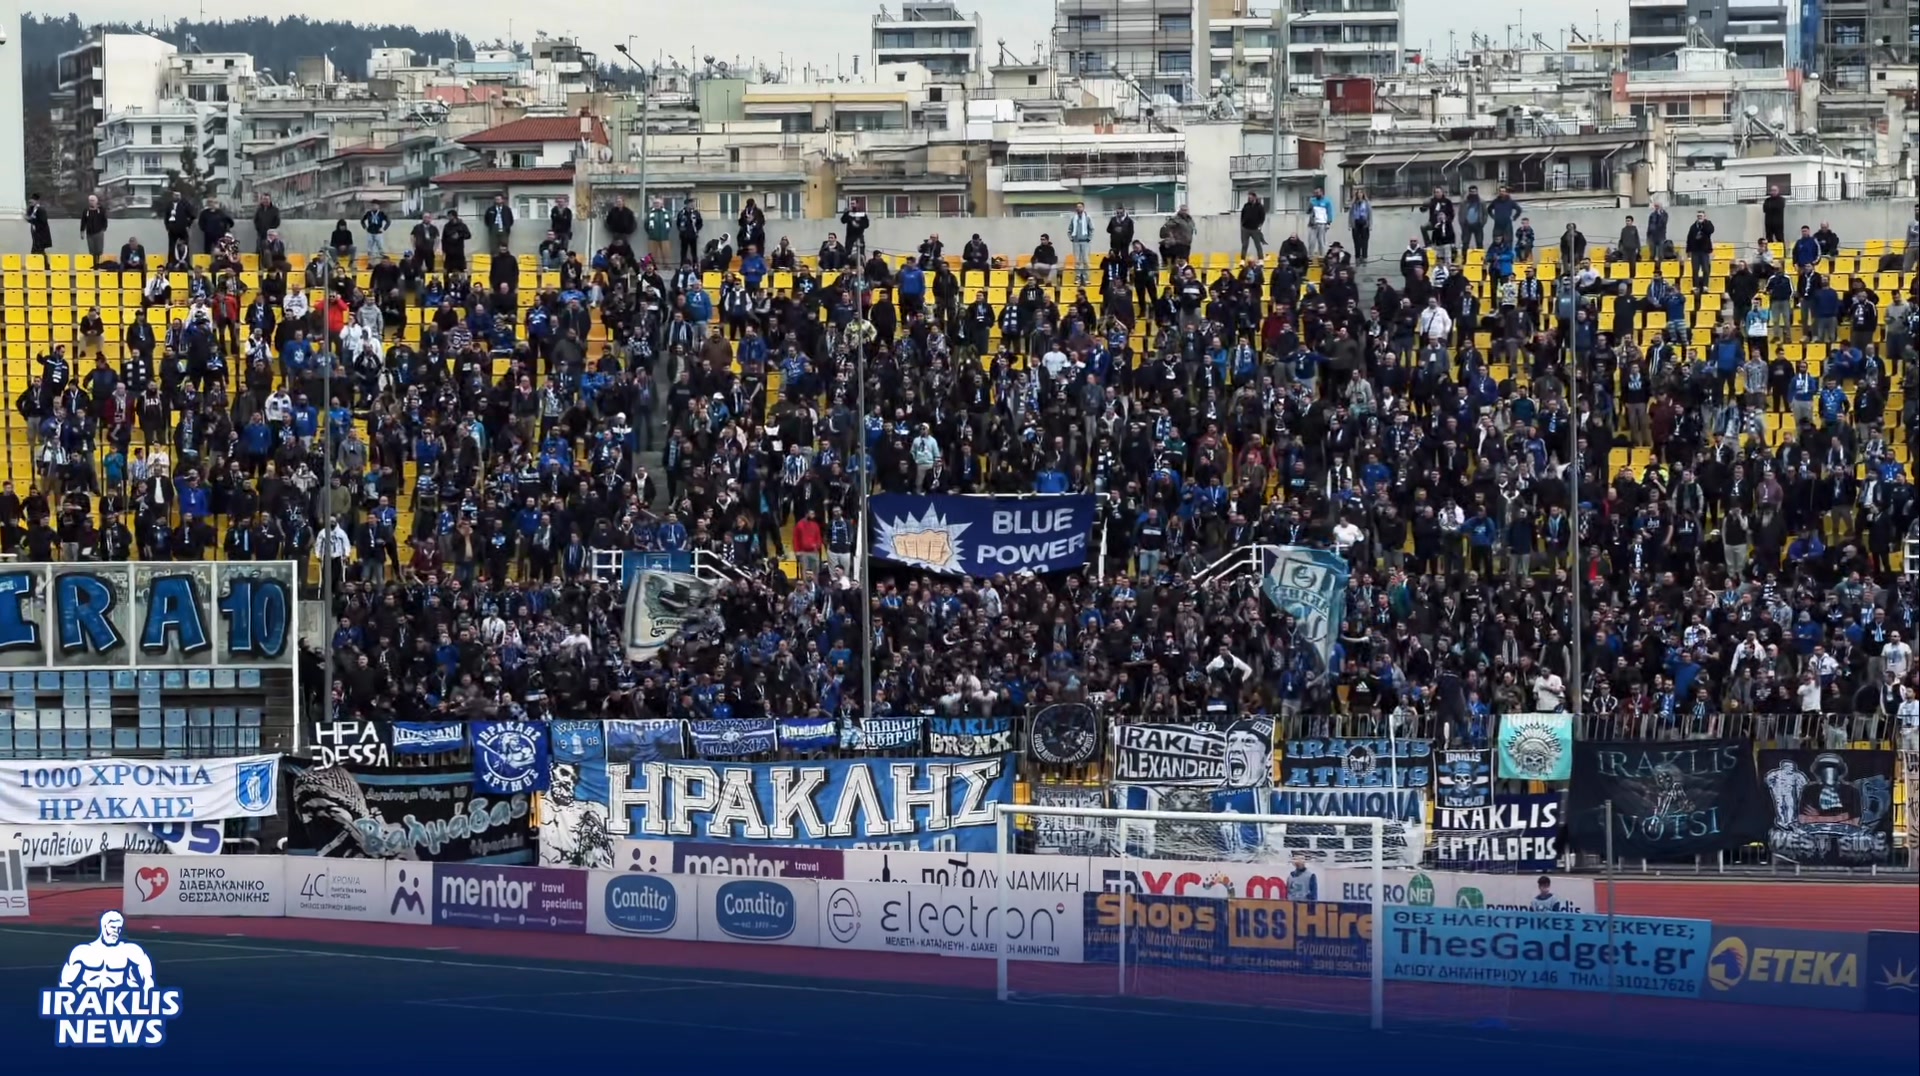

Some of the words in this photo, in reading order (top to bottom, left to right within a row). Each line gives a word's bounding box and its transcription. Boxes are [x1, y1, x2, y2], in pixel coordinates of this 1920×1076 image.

[992, 508, 1075, 535] BLUE
[976, 532, 1086, 565] POWER
[1119, 725, 1226, 757] IRAKLIS
[1117, 749, 1226, 778] ALEXANDRIA
[1597, 745, 1740, 778] IRAKLIS
[20, 767, 82, 788] 1000
[88, 764, 213, 786] ΧΡΟΝΙΑ
[37, 796, 195, 821] ΗΡΑΚΛΗΣ
[606, 757, 1001, 839] ΗΡΑΚΛΗΣ
[1441, 802, 1558, 830] IRAKLIS
[1616, 806, 1721, 842] VOTSI
[13, 831, 94, 862] ργαλείων
[1438, 836, 1557, 861] EPTALOFOS
[179, 868, 226, 879] ΙΑΤΡΙΚΟ
[684, 852, 786, 878] mentor
[794, 860, 820, 872] travel
[179, 880, 265, 891] ΔΙΑΒΑΛΚΑΝΙΚΟ
[179, 892, 270, 903] ΘΕΣΣΑΛΟΝΙΚΗΣ
[441, 874, 533, 910] mentor
[541, 882, 565, 894] travel
[612, 886, 668, 912] Condito
[1343, 882, 1405, 903] ELECRO
[1409, 886, 1434, 902] NET
[541, 897, 583, 911] specialists
[724, 891, 785, 918] Condito
[1096, 892, 1217, 935] Shops
[1296, 900, 1373, 939] Hire
[1393, 911, 1436, 926] ΘΕΣ
[1442, 913, 1576, 932] ΗΛΕΚΤΡΙΚΕΣ
[1582, 919, 1696, 940] ΣΥΣΚΕΥΕΣ;
[885, 936, 915, 947] ΜΕΛΕΤΗ
[1017, 945, 1060, 957] ΑΚΙΝΗΤΩΝ
[1393, 927, 1696, 975] ThesGadget.gr
[1394, 963, 1435, 977] ΑΓΙΟΥ
[1438, 965, 1527, 983] ΔΗΜΗΤΡΙΟΥ
[1532, 971, 1558, 984] 146
[1612, 974, 1696, 993] 310217626
